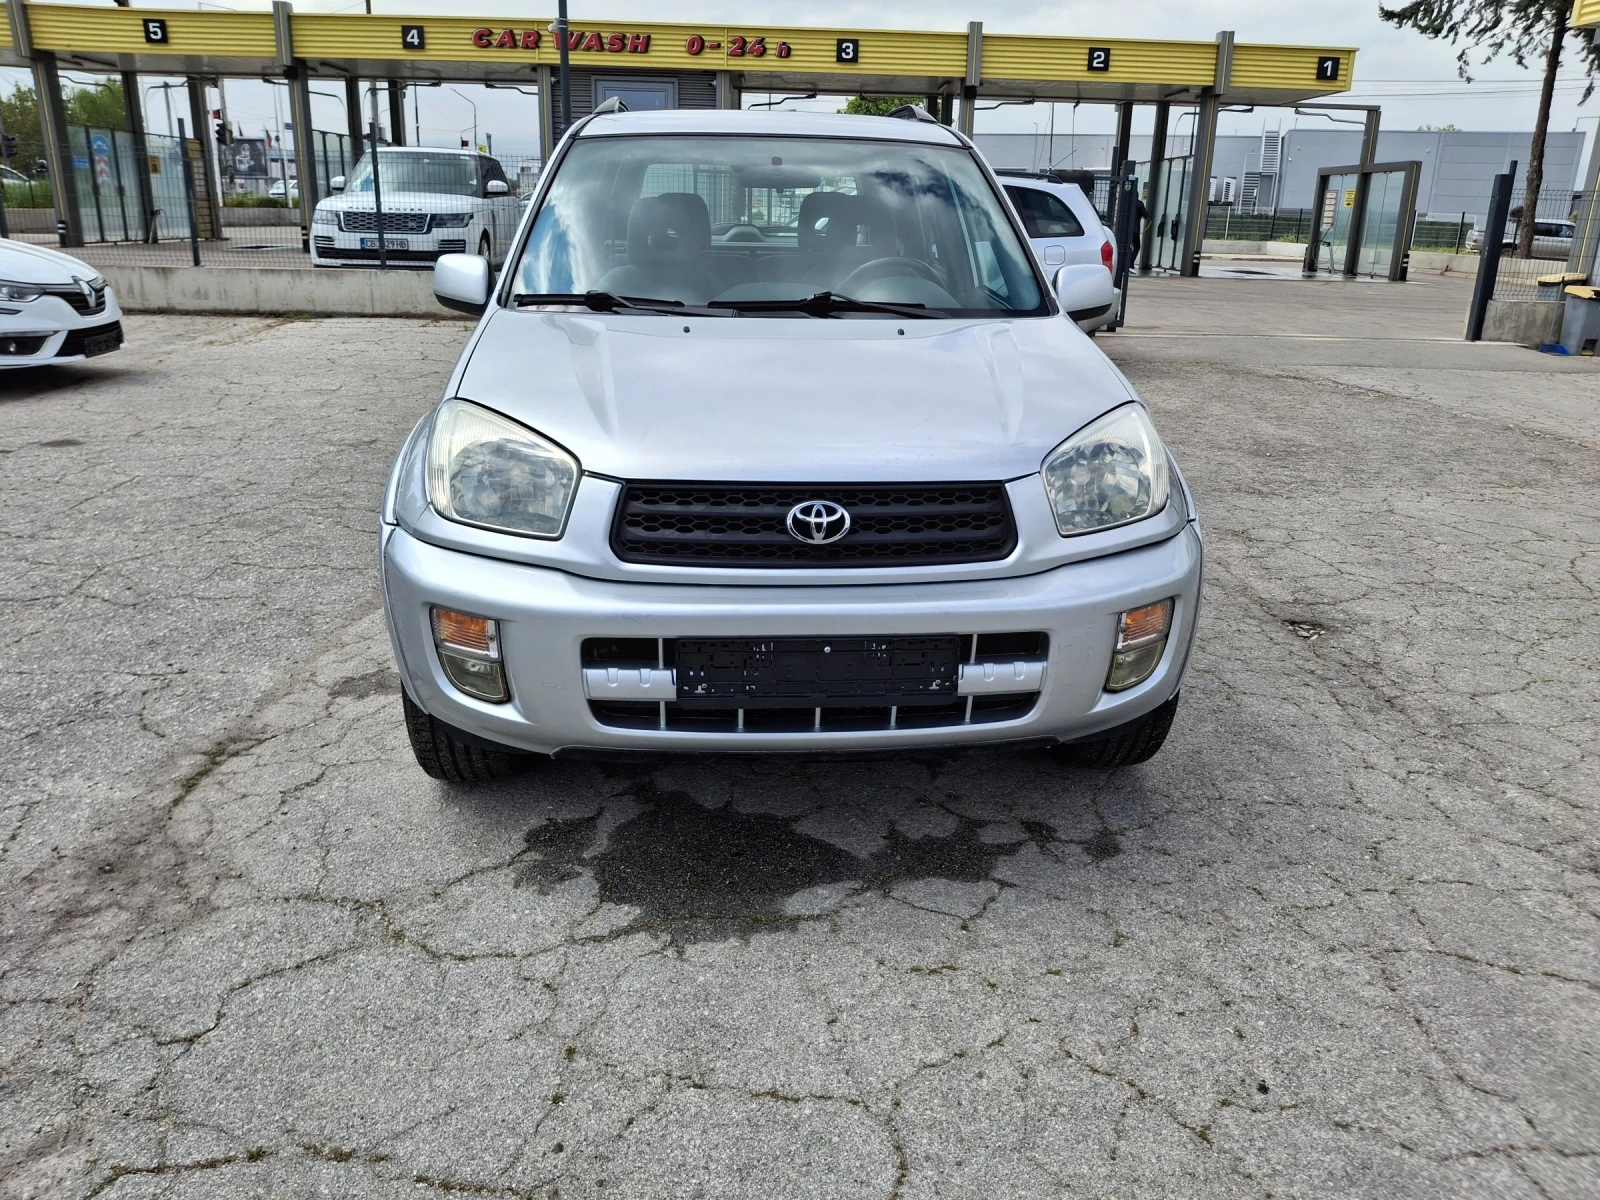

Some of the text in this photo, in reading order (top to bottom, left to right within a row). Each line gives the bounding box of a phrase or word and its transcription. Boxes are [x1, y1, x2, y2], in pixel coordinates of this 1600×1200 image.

[148, 22, 162, 39] 5
[406, 29, 420, 46] 4
[472, 28, 541, 48] CAR
[552, 31, 651, 53] WASH
[841, 42, 854, 59] 3
[1092, 51, 1105, 68] 2
[1323, 60, 1333, 77] 1
